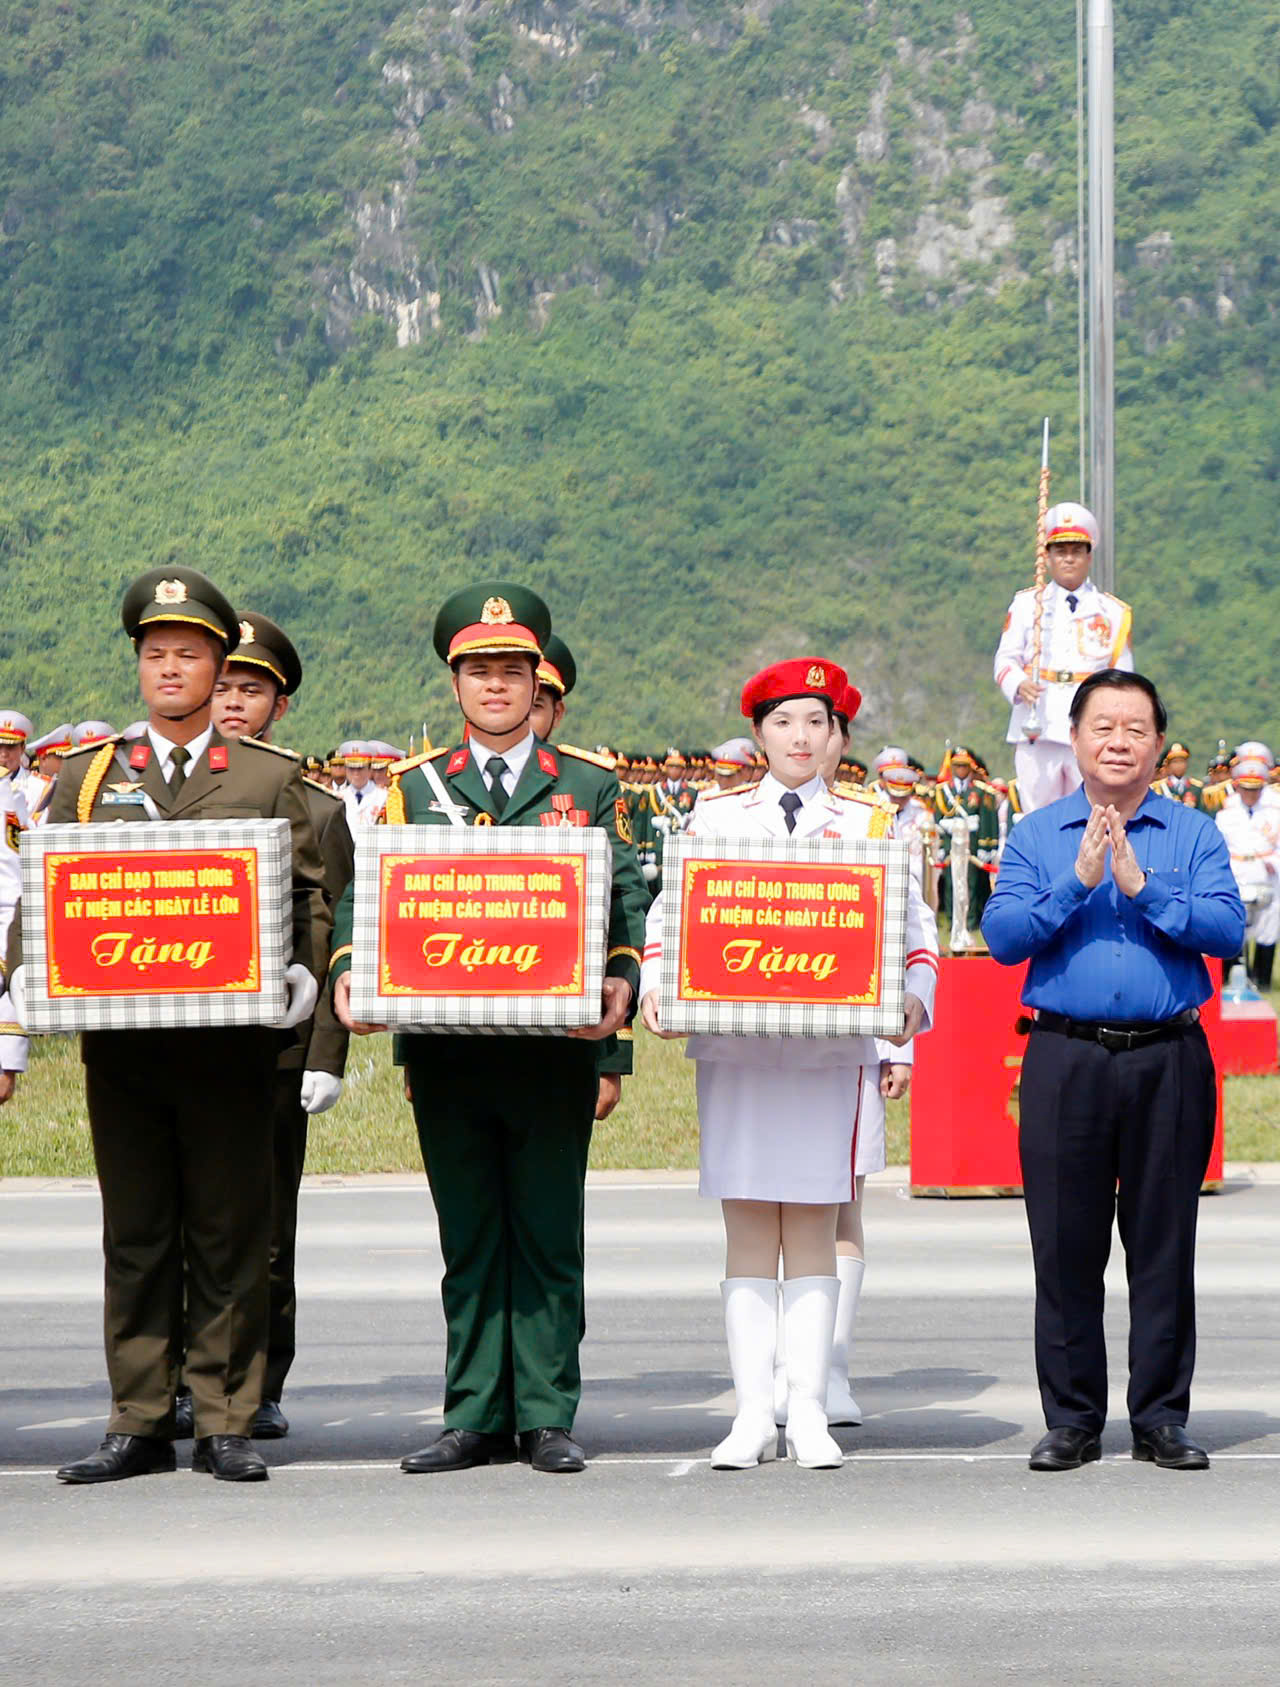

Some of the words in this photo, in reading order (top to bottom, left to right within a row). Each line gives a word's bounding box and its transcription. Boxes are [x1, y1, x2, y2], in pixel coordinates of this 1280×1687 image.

[70, 873, 98, 890] BAN
[100, 866, 122, 889] CHỈ
[124, 872, 151, 892] ĐẠO
[153, 870, 195, 888] TRUNG
[197, 868, 233, 887] ƯƠNG
[404, 874, 432, 891] BAN
[433, 868, 455, 891] CHỈ
[457, 874, 483, 895] ĐẠO
[484, 874, 526, 892] TRUNG
[527, 873, 562, 892] ƯƠNG
[707, 880, 734, 897] BAN
[735, 876, 756, 898] CHỈ
[758, 881, 783, 902] ĐẠO
[785, 882, 824, 900] TRUNG
[827, 882, 860, 901] ƯƠNG
[86, 898, 122, 920] NIỆM
[124, 897, 152, 916] CÁC
[154, 896, 191, 915] NGÀY
[212, 895, 239, 914] LỚN
[419, 899, 453, 921] NIỆM
[456, 899, 483, 919] CÁC
[485, 898, 521, 918] NGÀY
[540, 899, 567, 919] LỚN
[720, 905, 754, 928] NIỆM
[756, 906, 782, 926] CÁC
[784, 907, 819, 927] NGÀY
[839, 909, 864, 928] LỚN
[91, 932, 215, 970] Tặng
[423, 933, 541, 972] Tặng
[723, 939, 838, 980] Tặng
